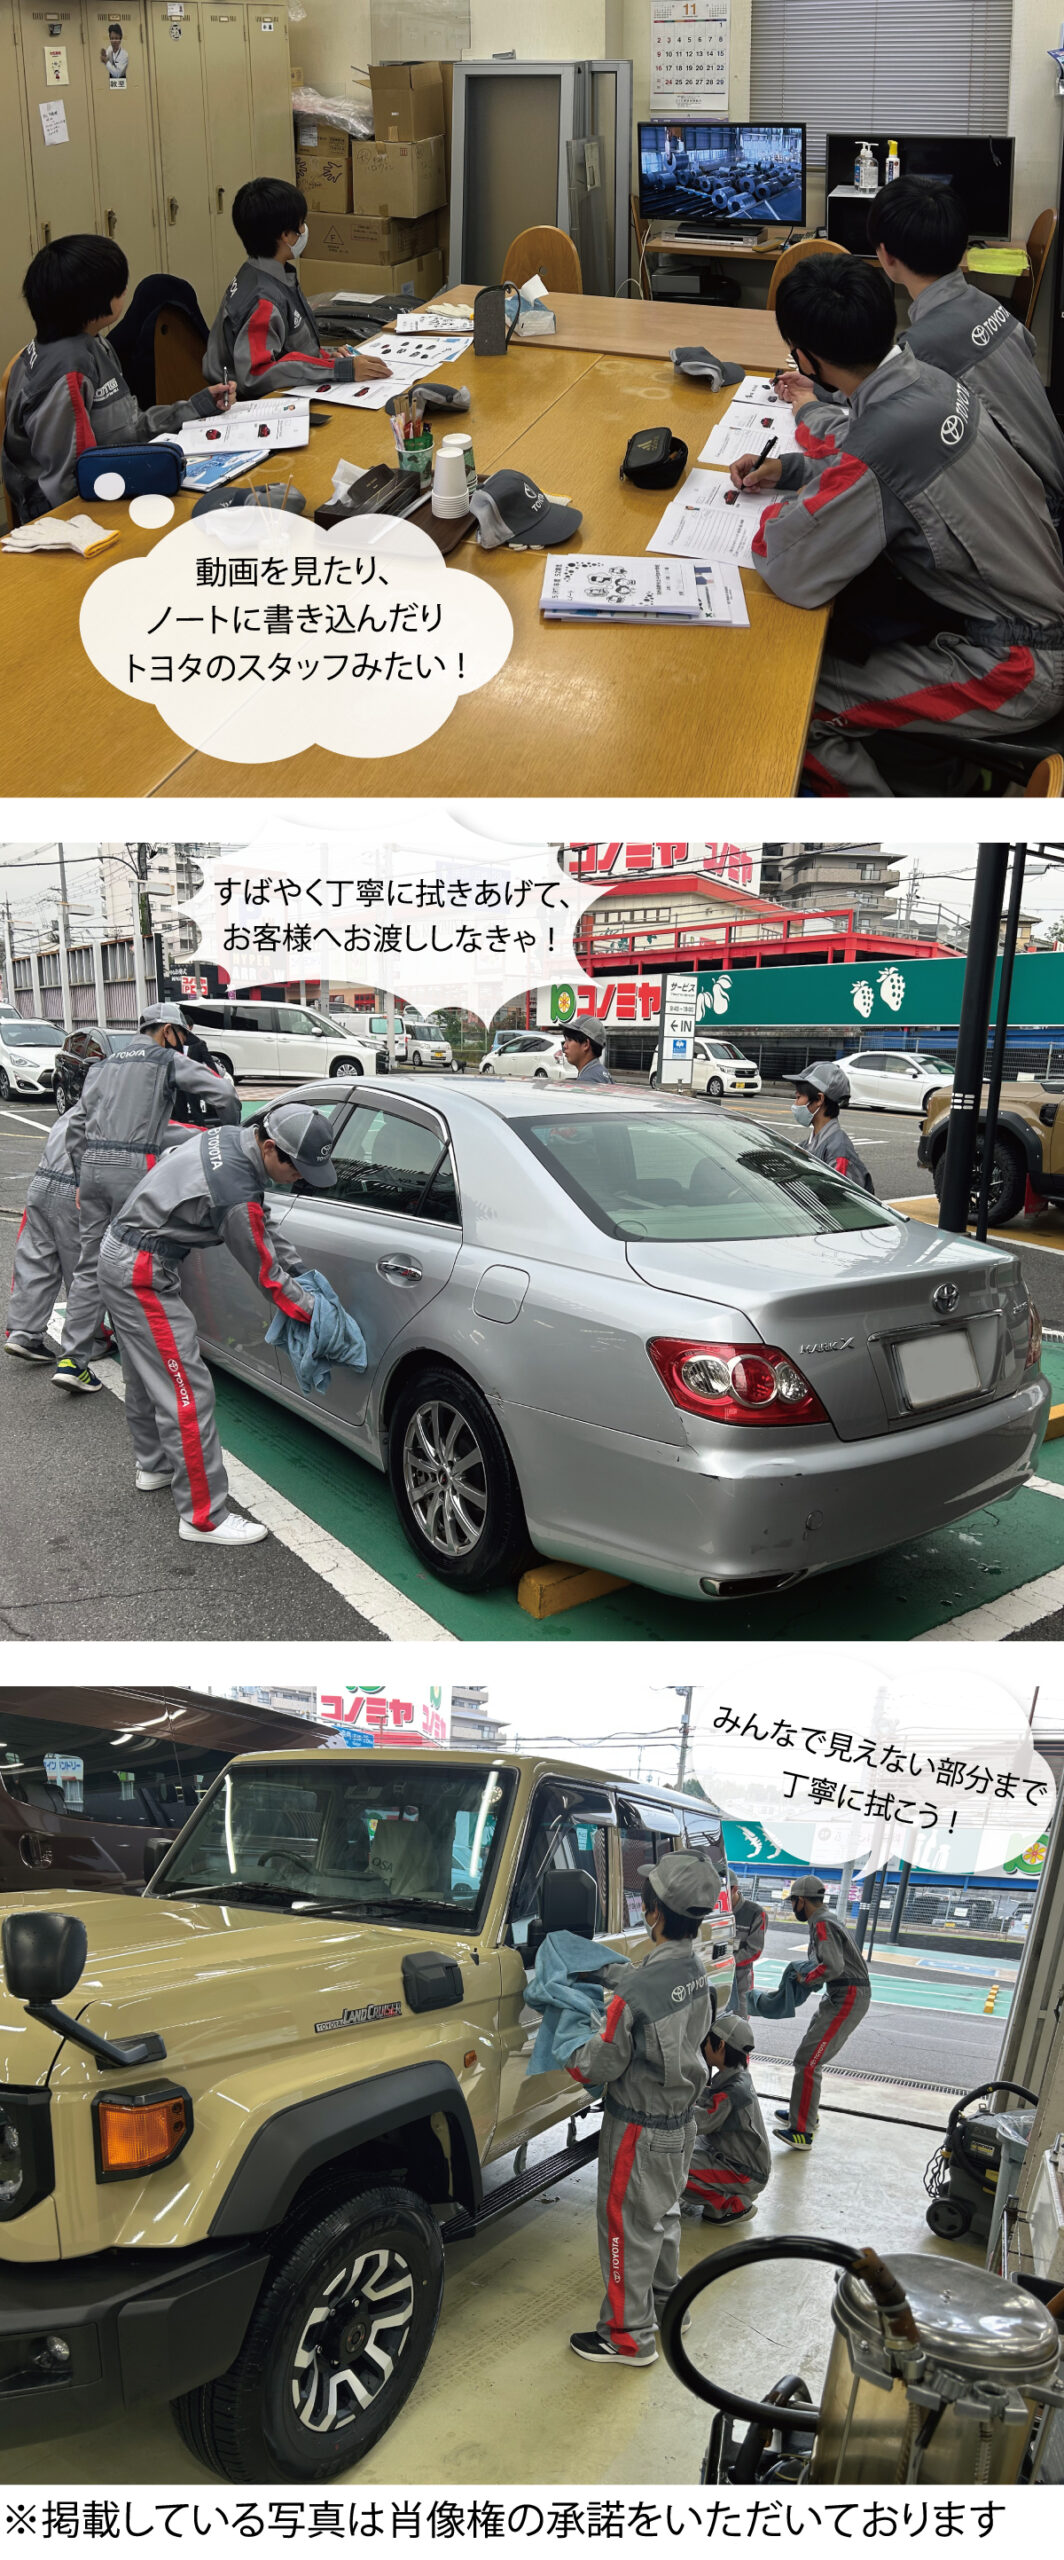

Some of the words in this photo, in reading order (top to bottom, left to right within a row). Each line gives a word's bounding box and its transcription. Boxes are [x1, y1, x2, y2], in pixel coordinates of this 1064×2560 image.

[683, 3, 697, 15] 11
[569, 843, 688, 873] コノミヤ
[577, 982, 662, 1020] コノミヤ
[670, 982, 696, 993] サービス
[680, 1020, 693, 1032] IN
[116, 1049, 146, 1059] TOYOTA
[208, 1134, 223, 1170] TOYOTA
[174, 1371, 191, 1408] TOYOTA
[320, 1695, 414, 1727] コノミヤ
[343, 2008, 367, 2024] LAND
[611, 2236, 620, 2270] TOYOTA
